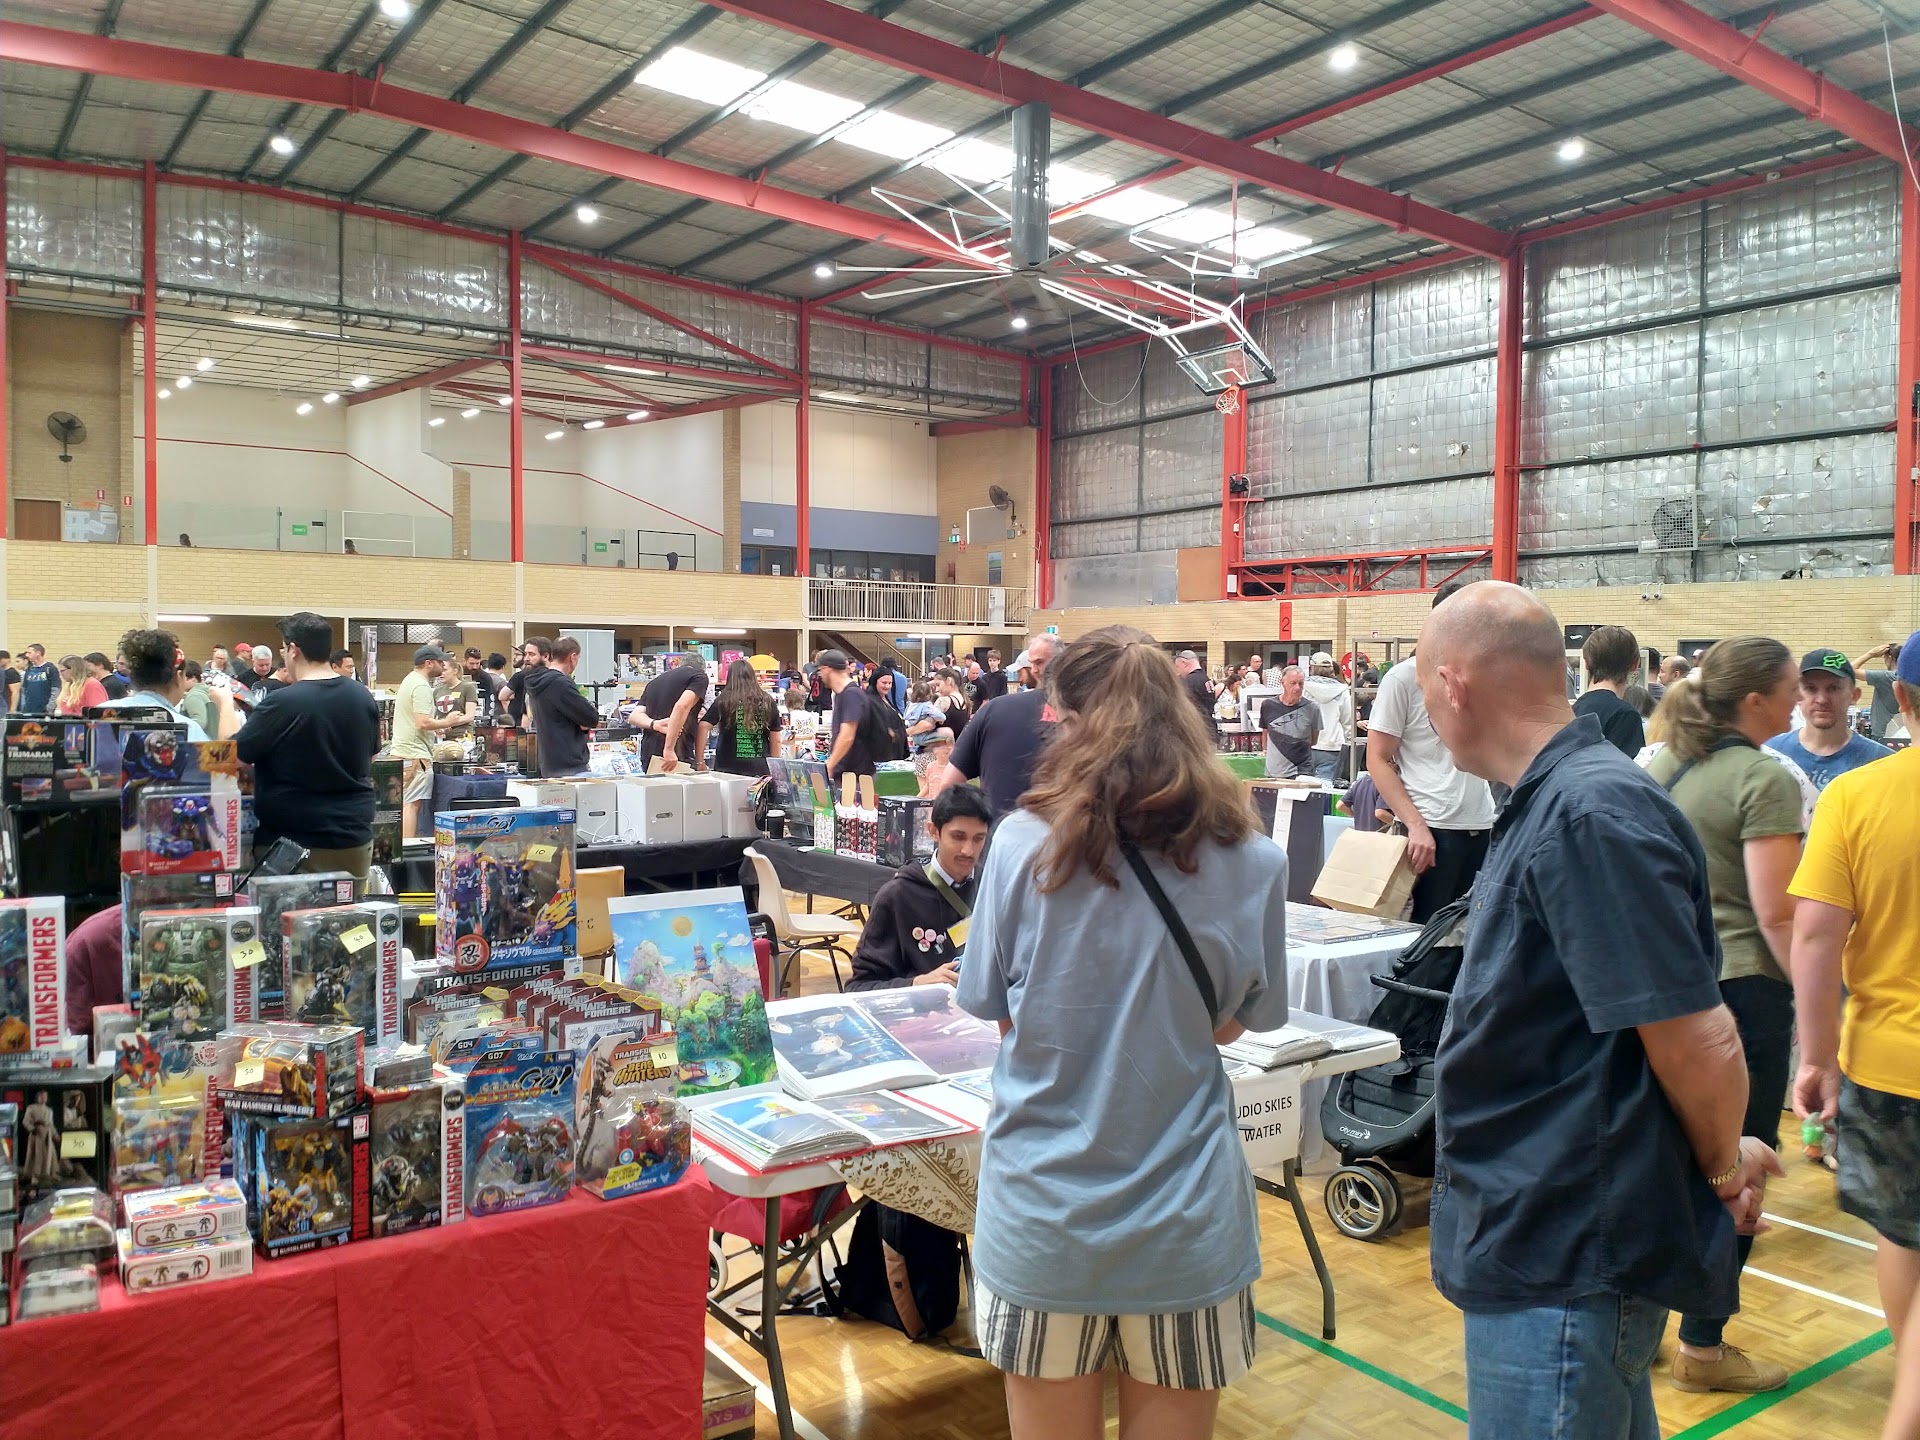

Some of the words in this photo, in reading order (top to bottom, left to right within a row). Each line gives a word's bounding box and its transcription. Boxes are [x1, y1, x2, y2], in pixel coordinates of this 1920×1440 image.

[1281, 616, 1290, 632] 2
[226, 799, 238, 867] TRANSFORMERS
[32, 916, 59, 1048] TRANSFORMERS
[434, 964, 551, 989] TRANSFORMERS
[382, 940, 398, 1037] TRANSFORMERS
[425, 994, 457, 1006] TRANS
[434, 997, 481, 1012] FORMERS
[575, 1001, 607, 1013] TRANS
[584, 1006, 632, 1019] FORMERS
[457, 1040, 474, 1049] G04
[487, 1052, 504, 1060] G07
[614, 1048, 652, 1060] TRANSFO
[627, 1060, 654, 1073] BEAS
[613, 1066, 672, 1087] HUNTERS
[1264, 1096, 1293, 1113] SKIES
[1244, 1122, 1282, 1142] WATER
[447, 1116, 463, 1218] TRANSFORMERS
